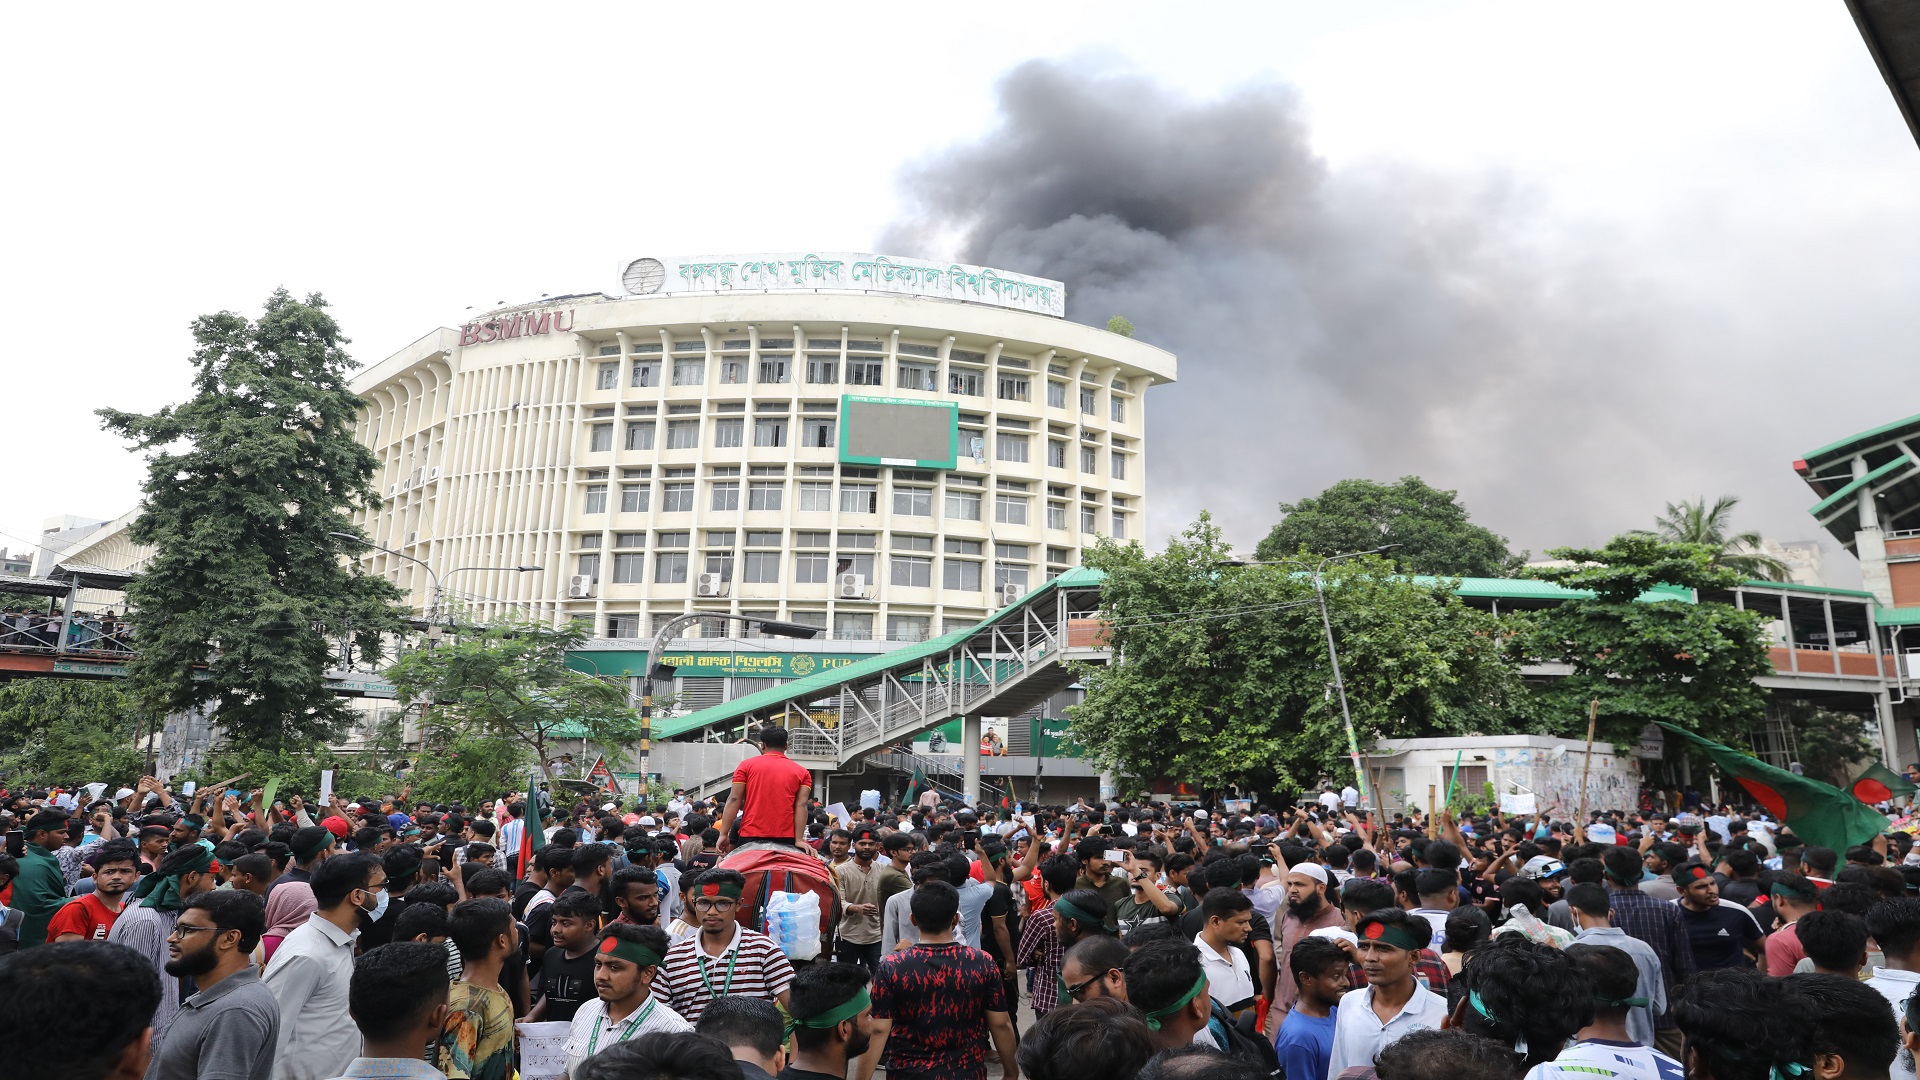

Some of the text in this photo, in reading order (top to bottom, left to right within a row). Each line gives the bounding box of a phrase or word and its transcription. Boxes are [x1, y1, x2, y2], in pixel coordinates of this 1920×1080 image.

[679, 263, 738, 286] বঙ্গবন্ধু
[741, 260, 784, 281] শেখ
[787, 254, 844, 284] মুজিব
[458, 309, 575, 346] BSMMU
